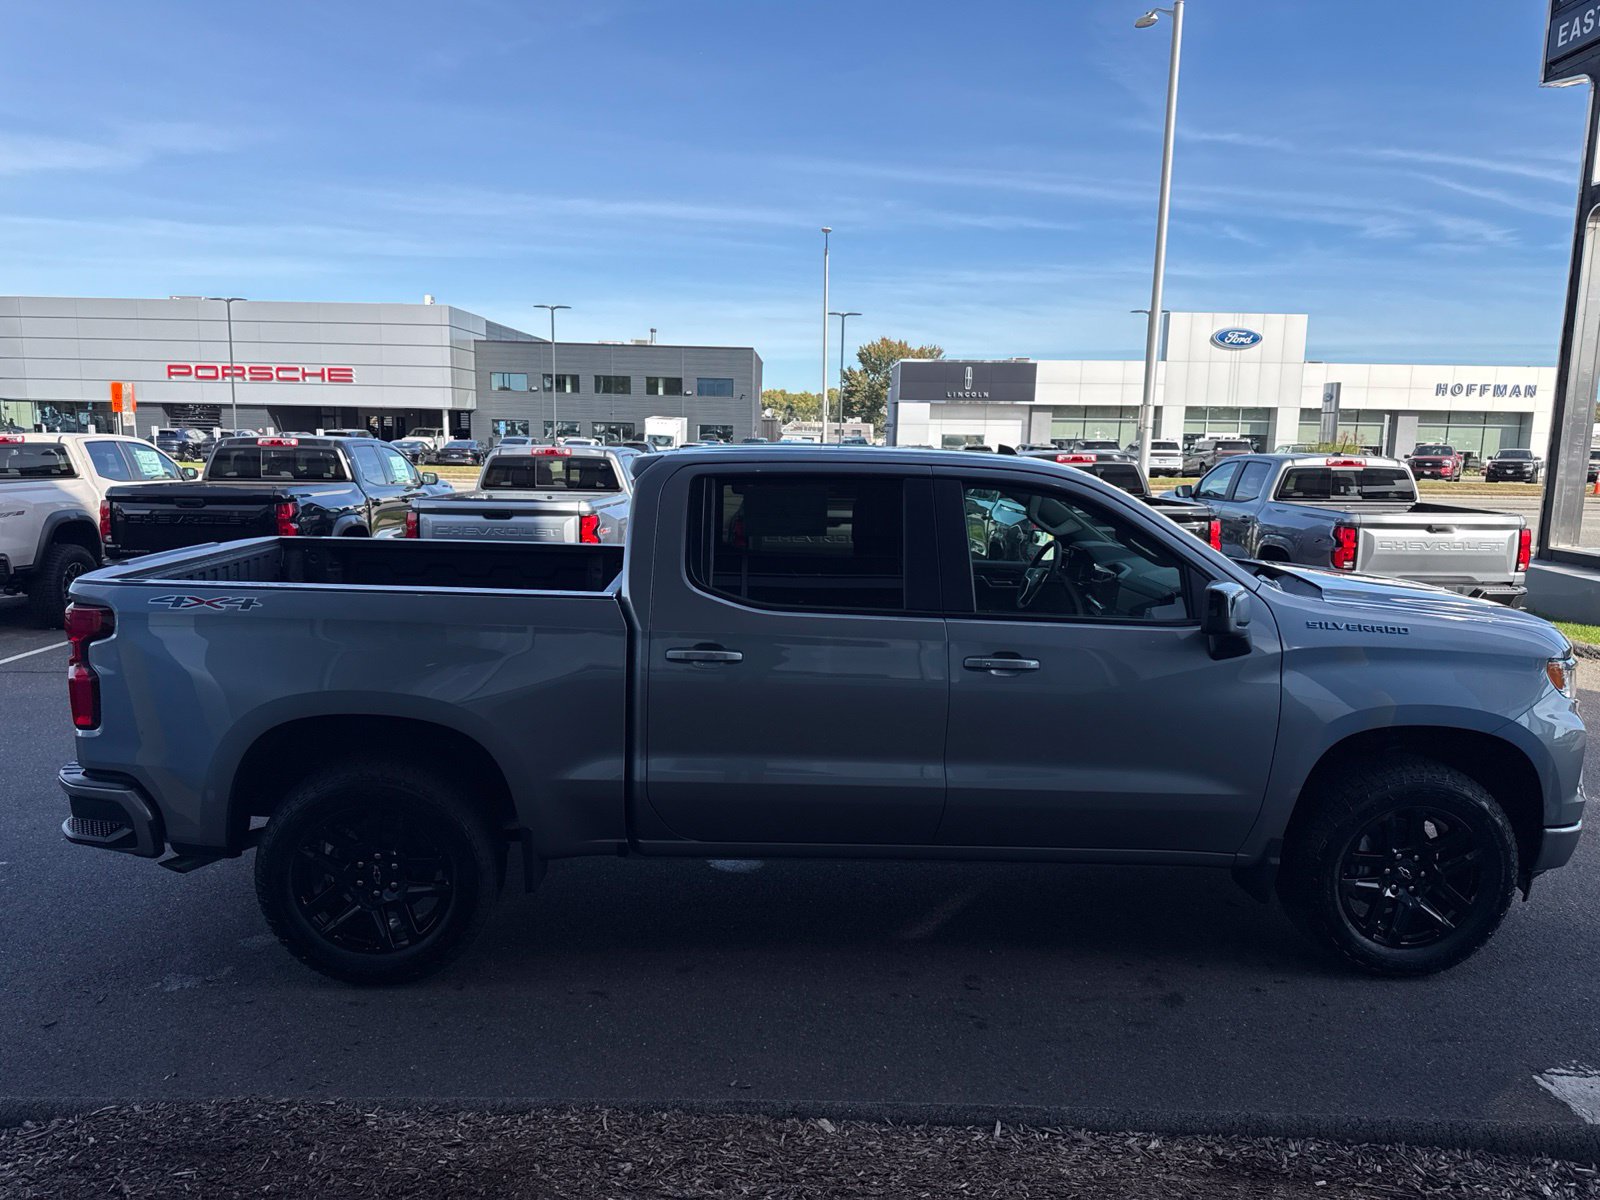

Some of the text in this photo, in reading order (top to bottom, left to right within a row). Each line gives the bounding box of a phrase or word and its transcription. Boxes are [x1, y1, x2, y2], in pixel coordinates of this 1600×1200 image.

[1224, 331, 1254, 344] Ford
[167, 364, 354, 383] PORSCHE
[1435, 383, 1537, 398] HOFFMAN
[433, 526, 561, 537] CHEVROLET
[1377, 540, 1505, 551] CHEVROLET
[1305, 621, 1409, 635] SILVERADO
